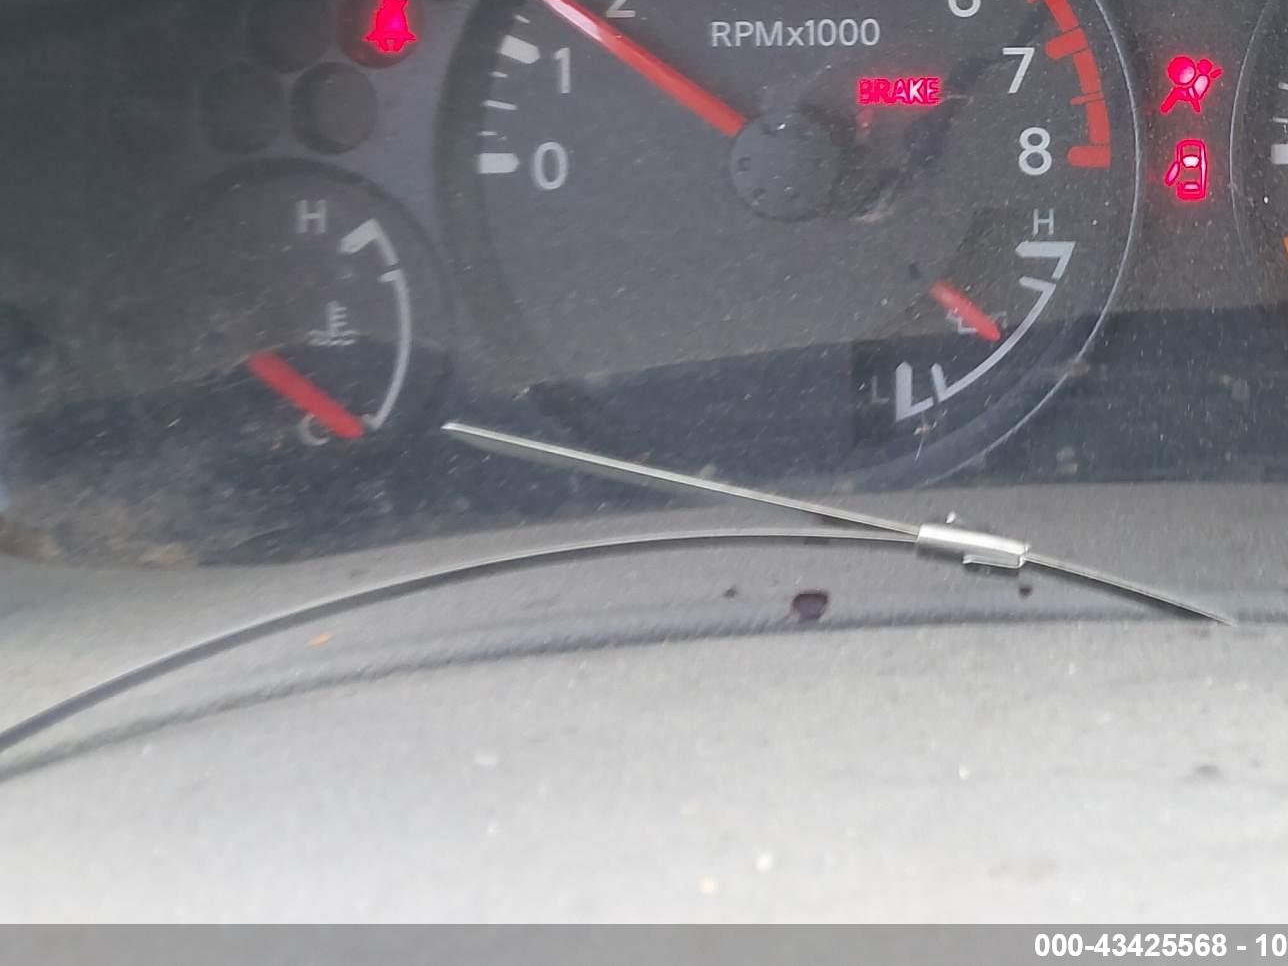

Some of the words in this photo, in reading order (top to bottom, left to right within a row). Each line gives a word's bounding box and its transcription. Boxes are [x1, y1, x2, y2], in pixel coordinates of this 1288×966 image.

[711, 18, 881, 47] RPMx1000
[553, 47, 571, 94] 1
[1002, 47, 1036, 94] 7
[857, 77, 941, 106] BRAKE
[533, 141, 569, 190] 0
[1018, 127, 1052, 176] 8
[296, 200, 327, 234] H
[1033, 208, 1055, 235] H
